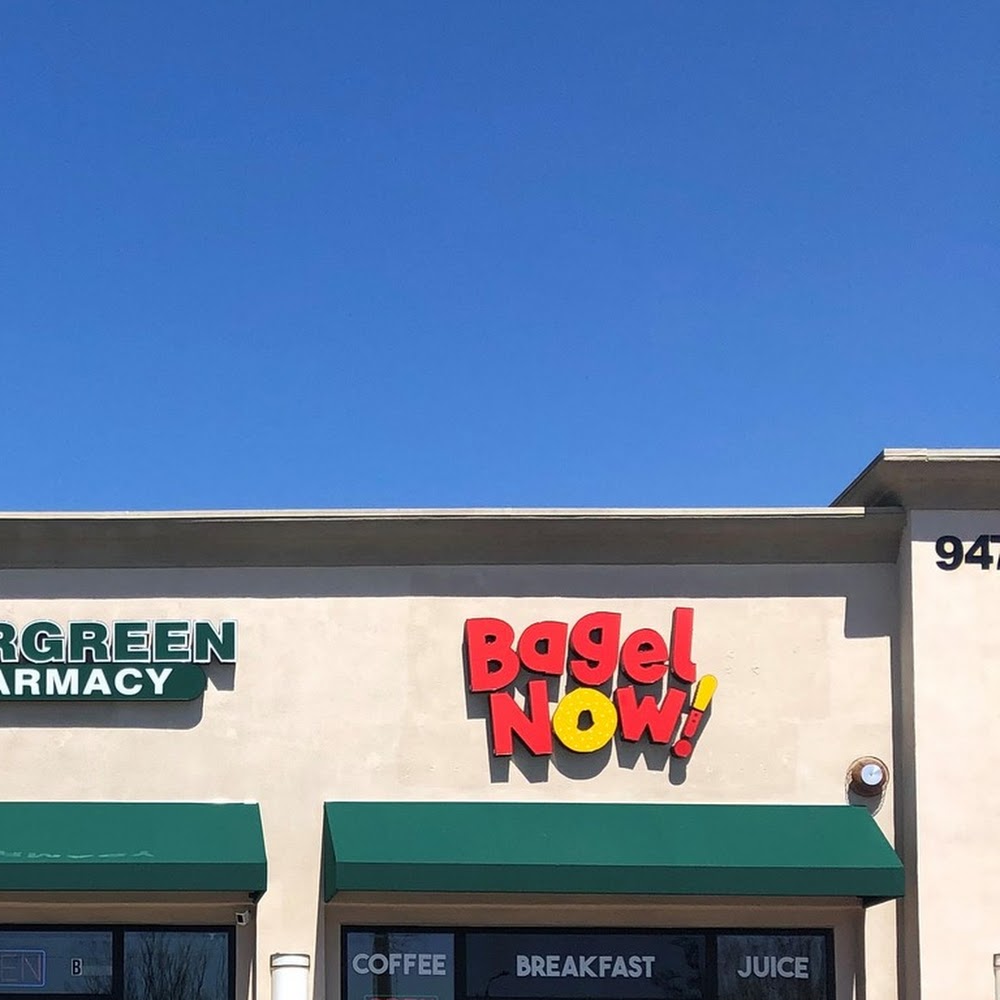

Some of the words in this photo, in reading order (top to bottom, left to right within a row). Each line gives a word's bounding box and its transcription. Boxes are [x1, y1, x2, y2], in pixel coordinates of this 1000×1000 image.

[464, 607, 697, 693] Bagel
[72, 959, 82, 976] B
[352, 953, 447, 976] COFFEE
[516, 955, 656, 978] BREAKFAST
[737, 956, 810, 979] JUICE
